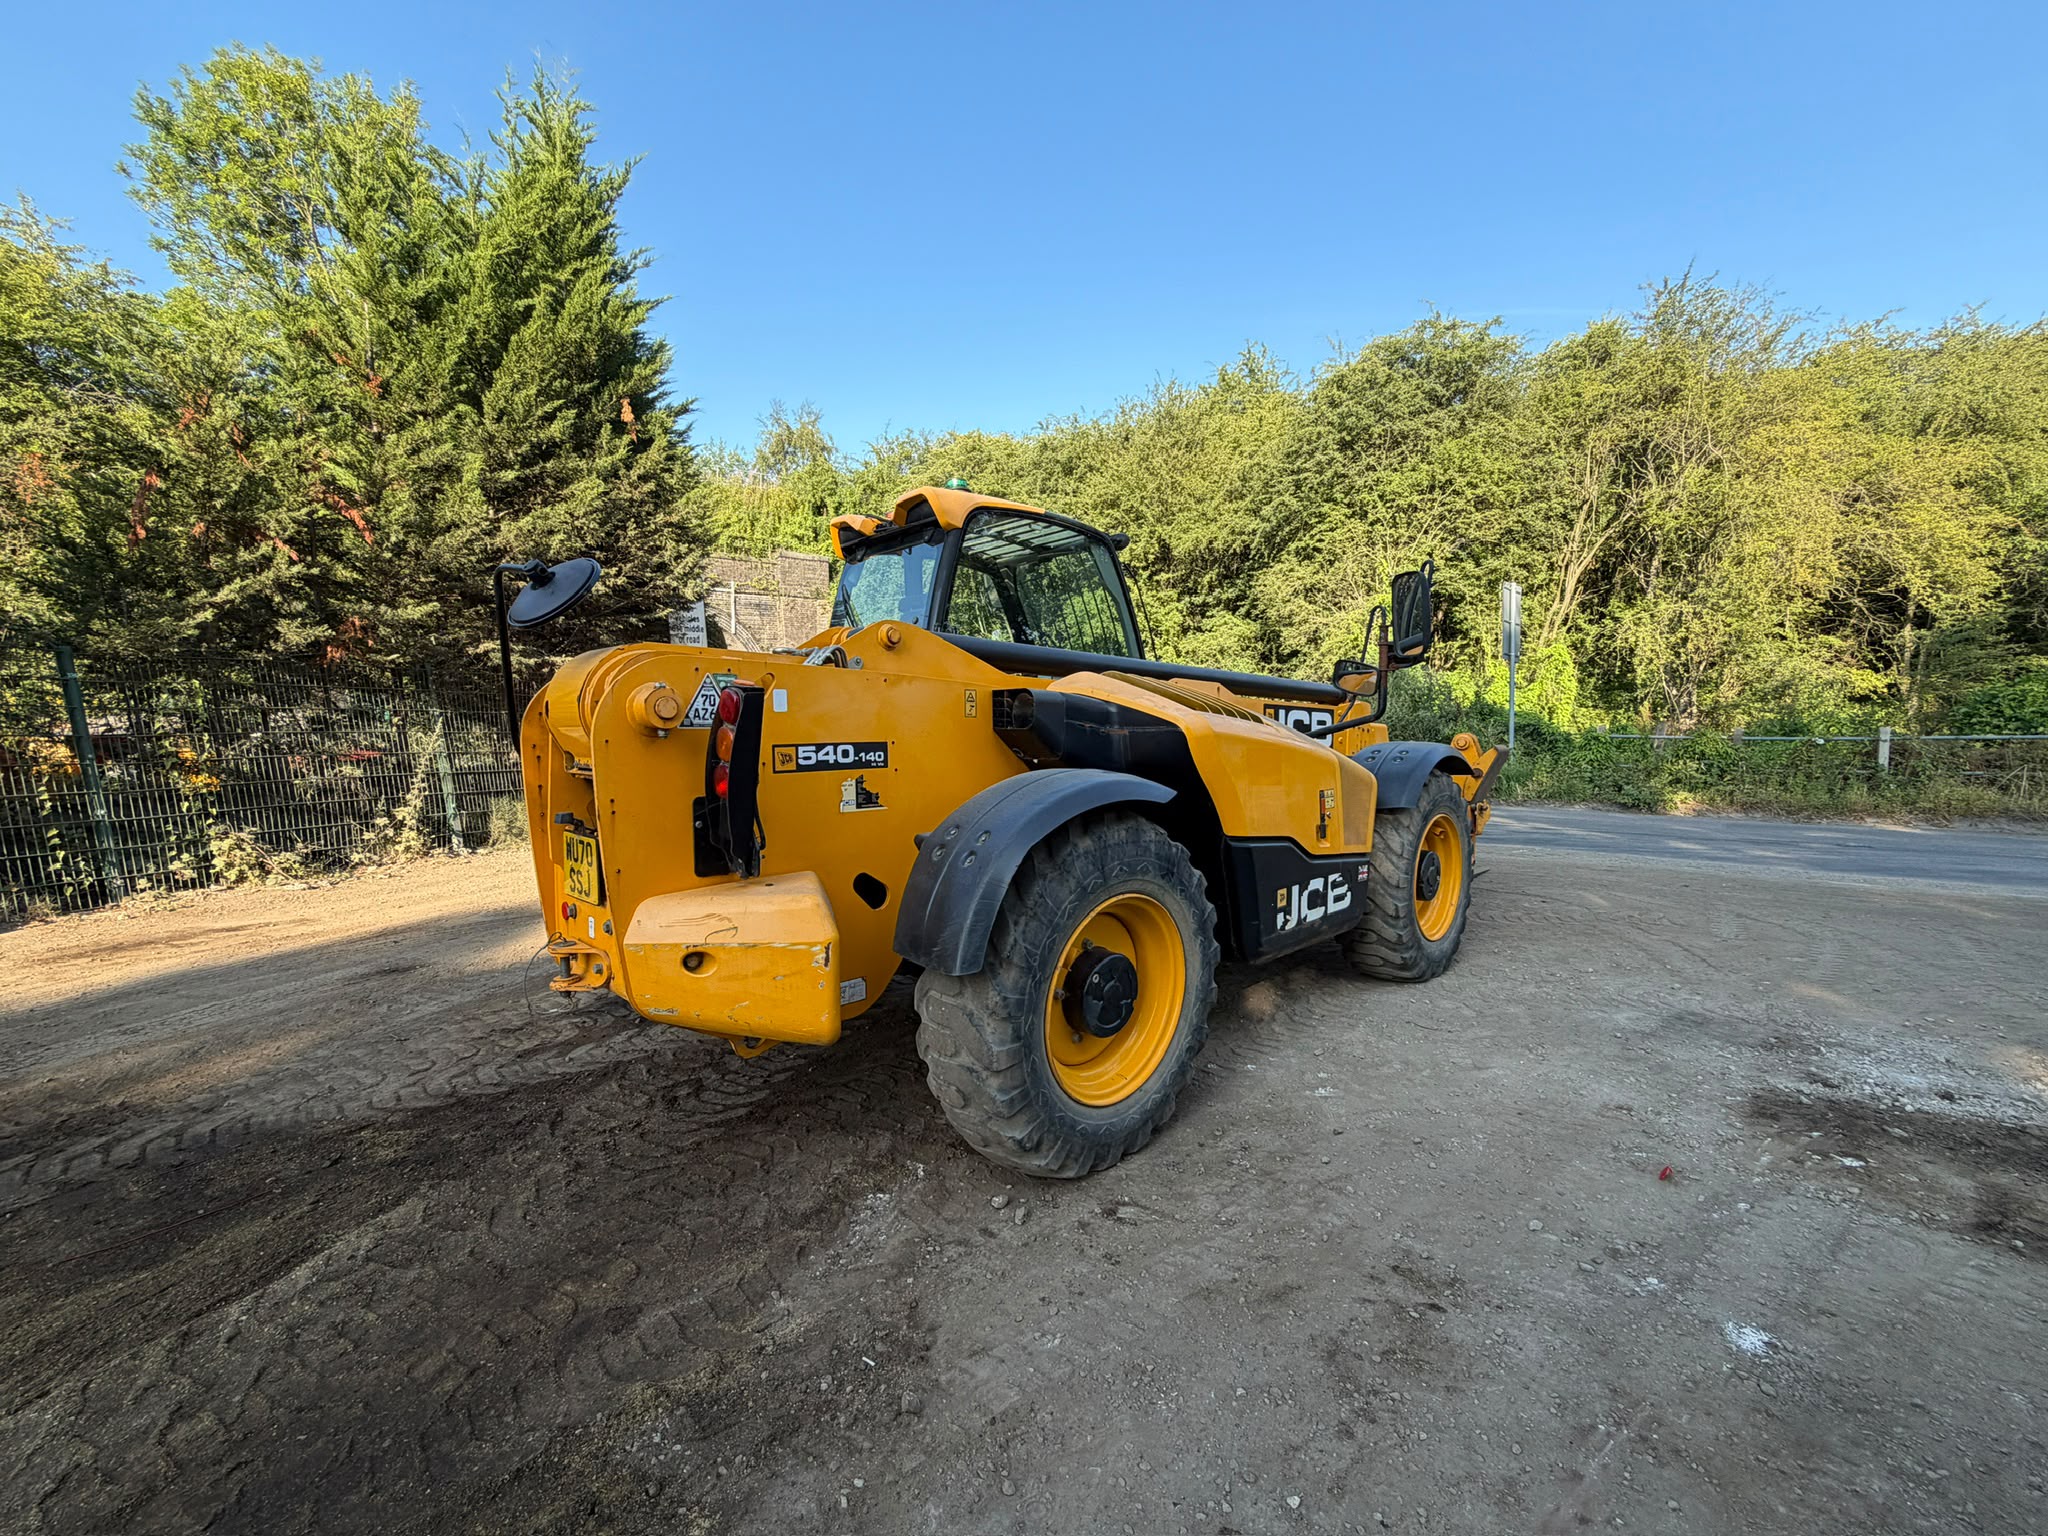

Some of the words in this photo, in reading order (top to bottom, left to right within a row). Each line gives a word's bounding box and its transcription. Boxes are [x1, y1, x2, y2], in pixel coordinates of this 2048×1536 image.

[684, 624, 704, 633] middle
[686, 635, 700, 644] road
[701, 694, 716, 707] 70
[565, 836, 593, 867] WU70
[569, 866, 591, 898] SSJ
[1276, 872, 1352, 931] JCB
